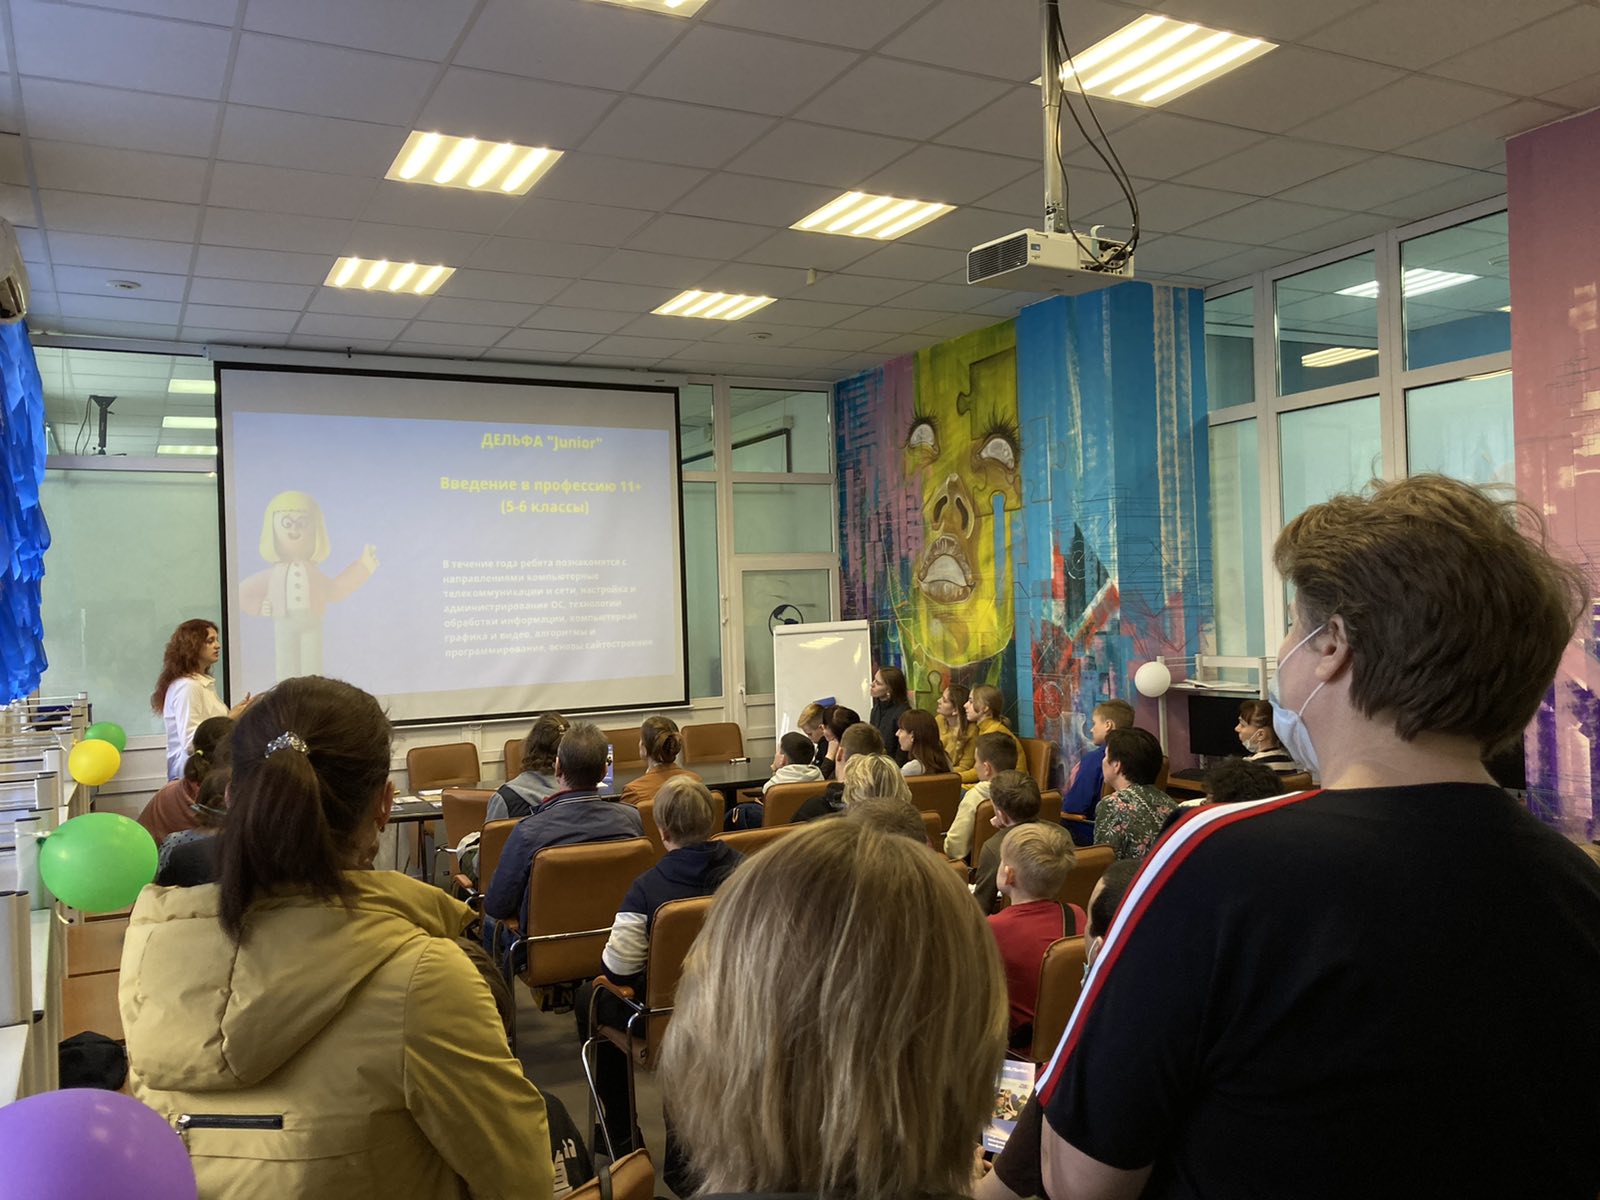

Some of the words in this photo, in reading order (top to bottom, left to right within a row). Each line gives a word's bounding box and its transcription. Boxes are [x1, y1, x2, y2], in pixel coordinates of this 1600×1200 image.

[481, 433, 543, 449] ДЕЛЬФА
[547, 436, 603, 452] "Junior"
[440, 476, 517, 493] Введение
[521, 481, 530, 491] в
[534, 479, 616, 494] профессию
[620, 481, 641, 493] 11+
[501, 500, 527, 515] (5-6
[531, 501, 589, 515] классы)
[451, 560, 494, 568] течение
[496, 560, 518, 569] года
[443, 576, 524, 585] направлениями
[443, 590, 543, 599] телекоммуникации
[444, 618, 498, 628] обработки
[444, 633, 488, 643] графика
